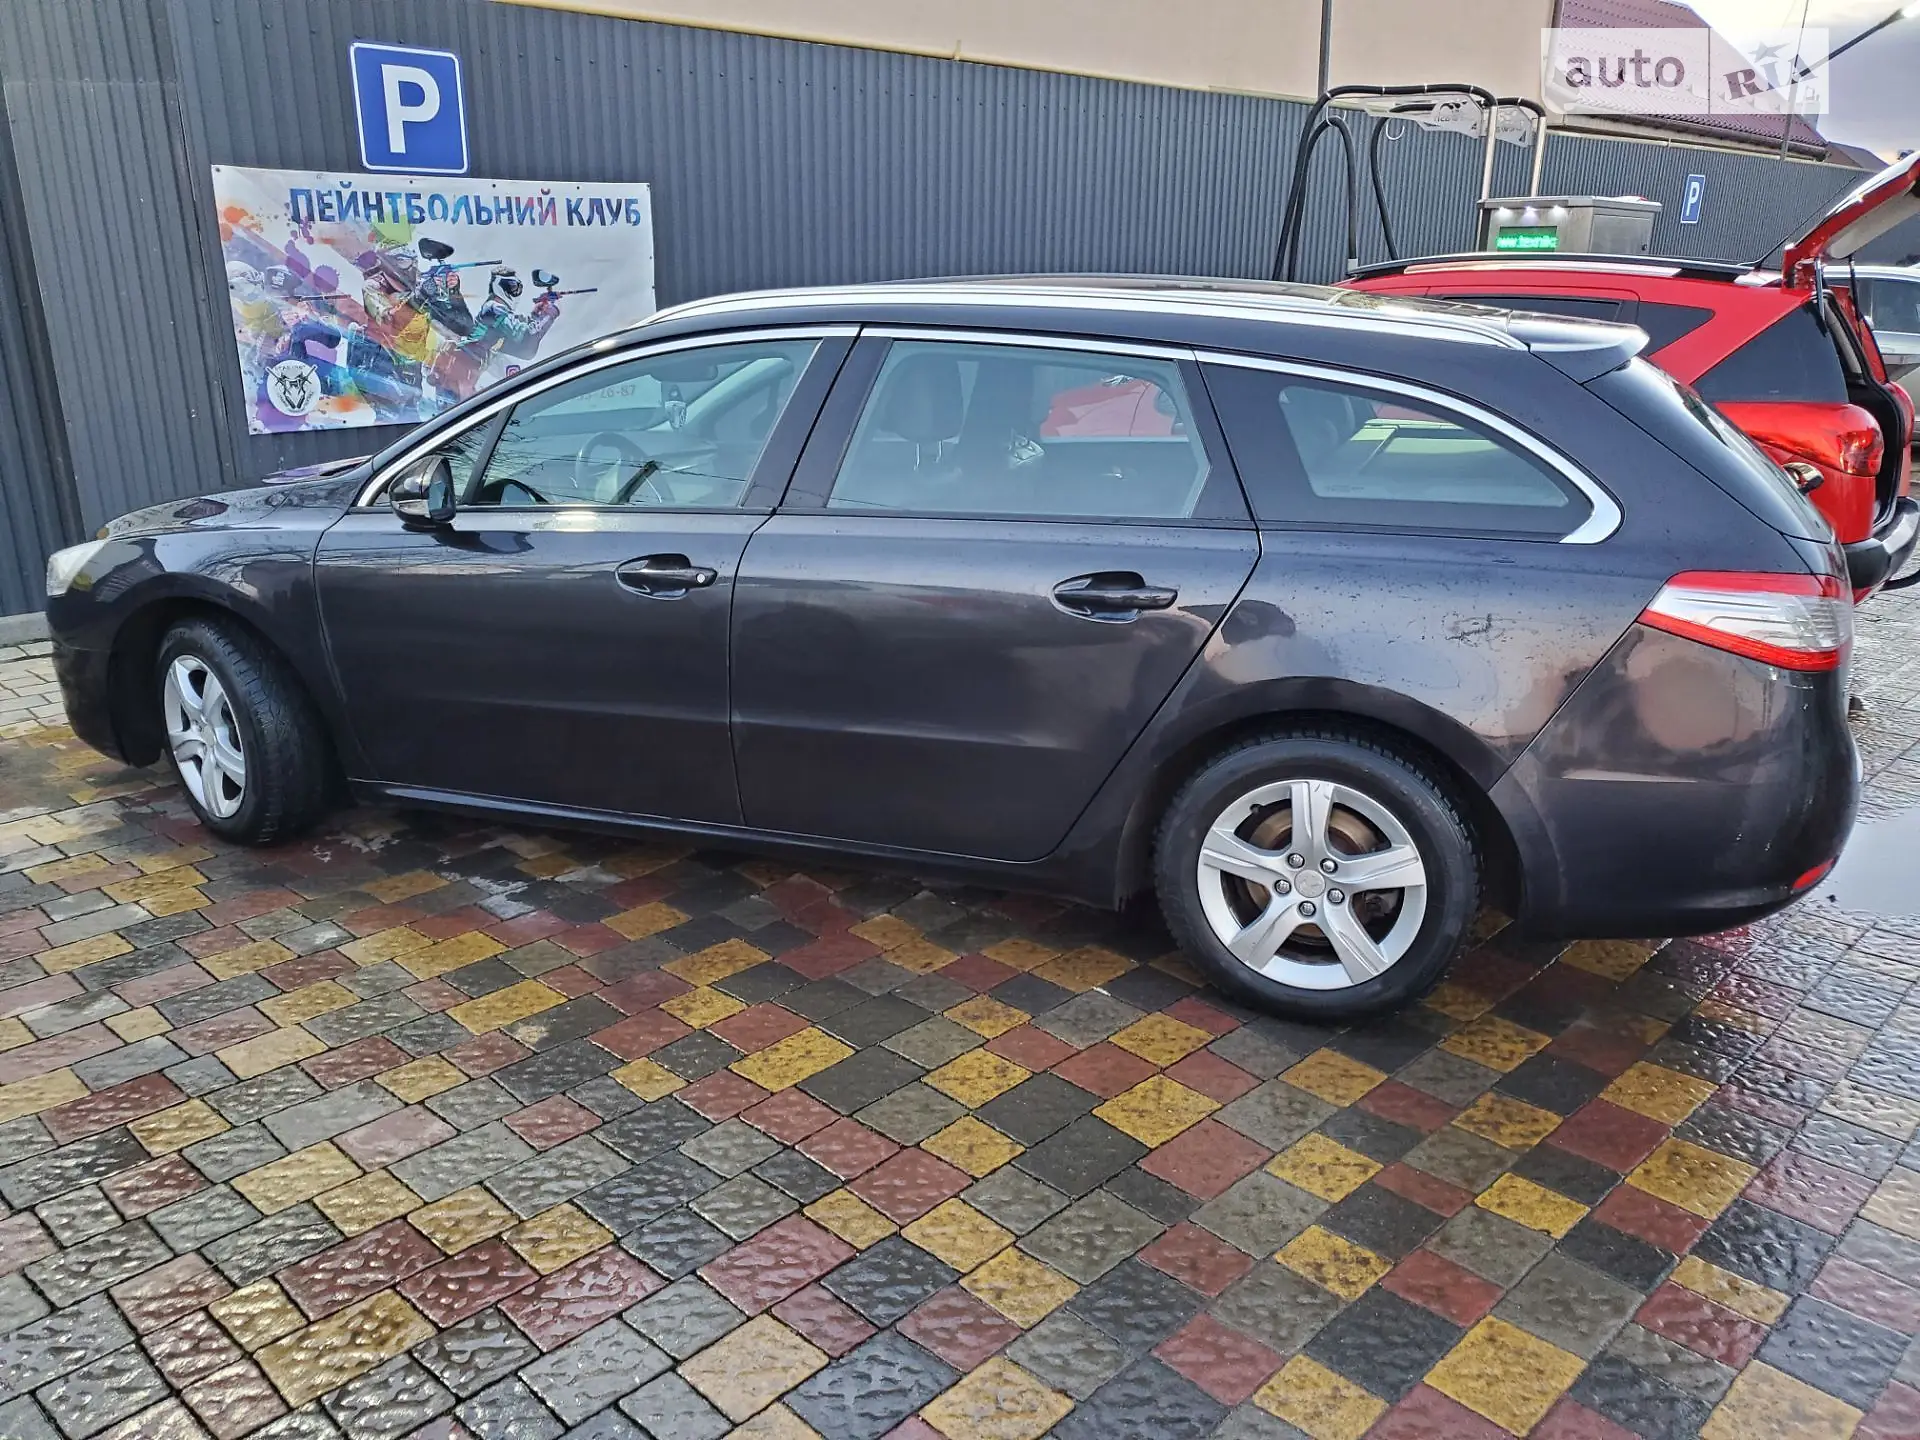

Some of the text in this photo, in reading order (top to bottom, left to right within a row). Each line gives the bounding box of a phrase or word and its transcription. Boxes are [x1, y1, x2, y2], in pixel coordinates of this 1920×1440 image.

[381, 64, 440, 153] P
[289, 180, 641, 227] ПЕЙНТБОЛЬНИЙ КЛУБ
[1686, 181, 1699, 216] P
